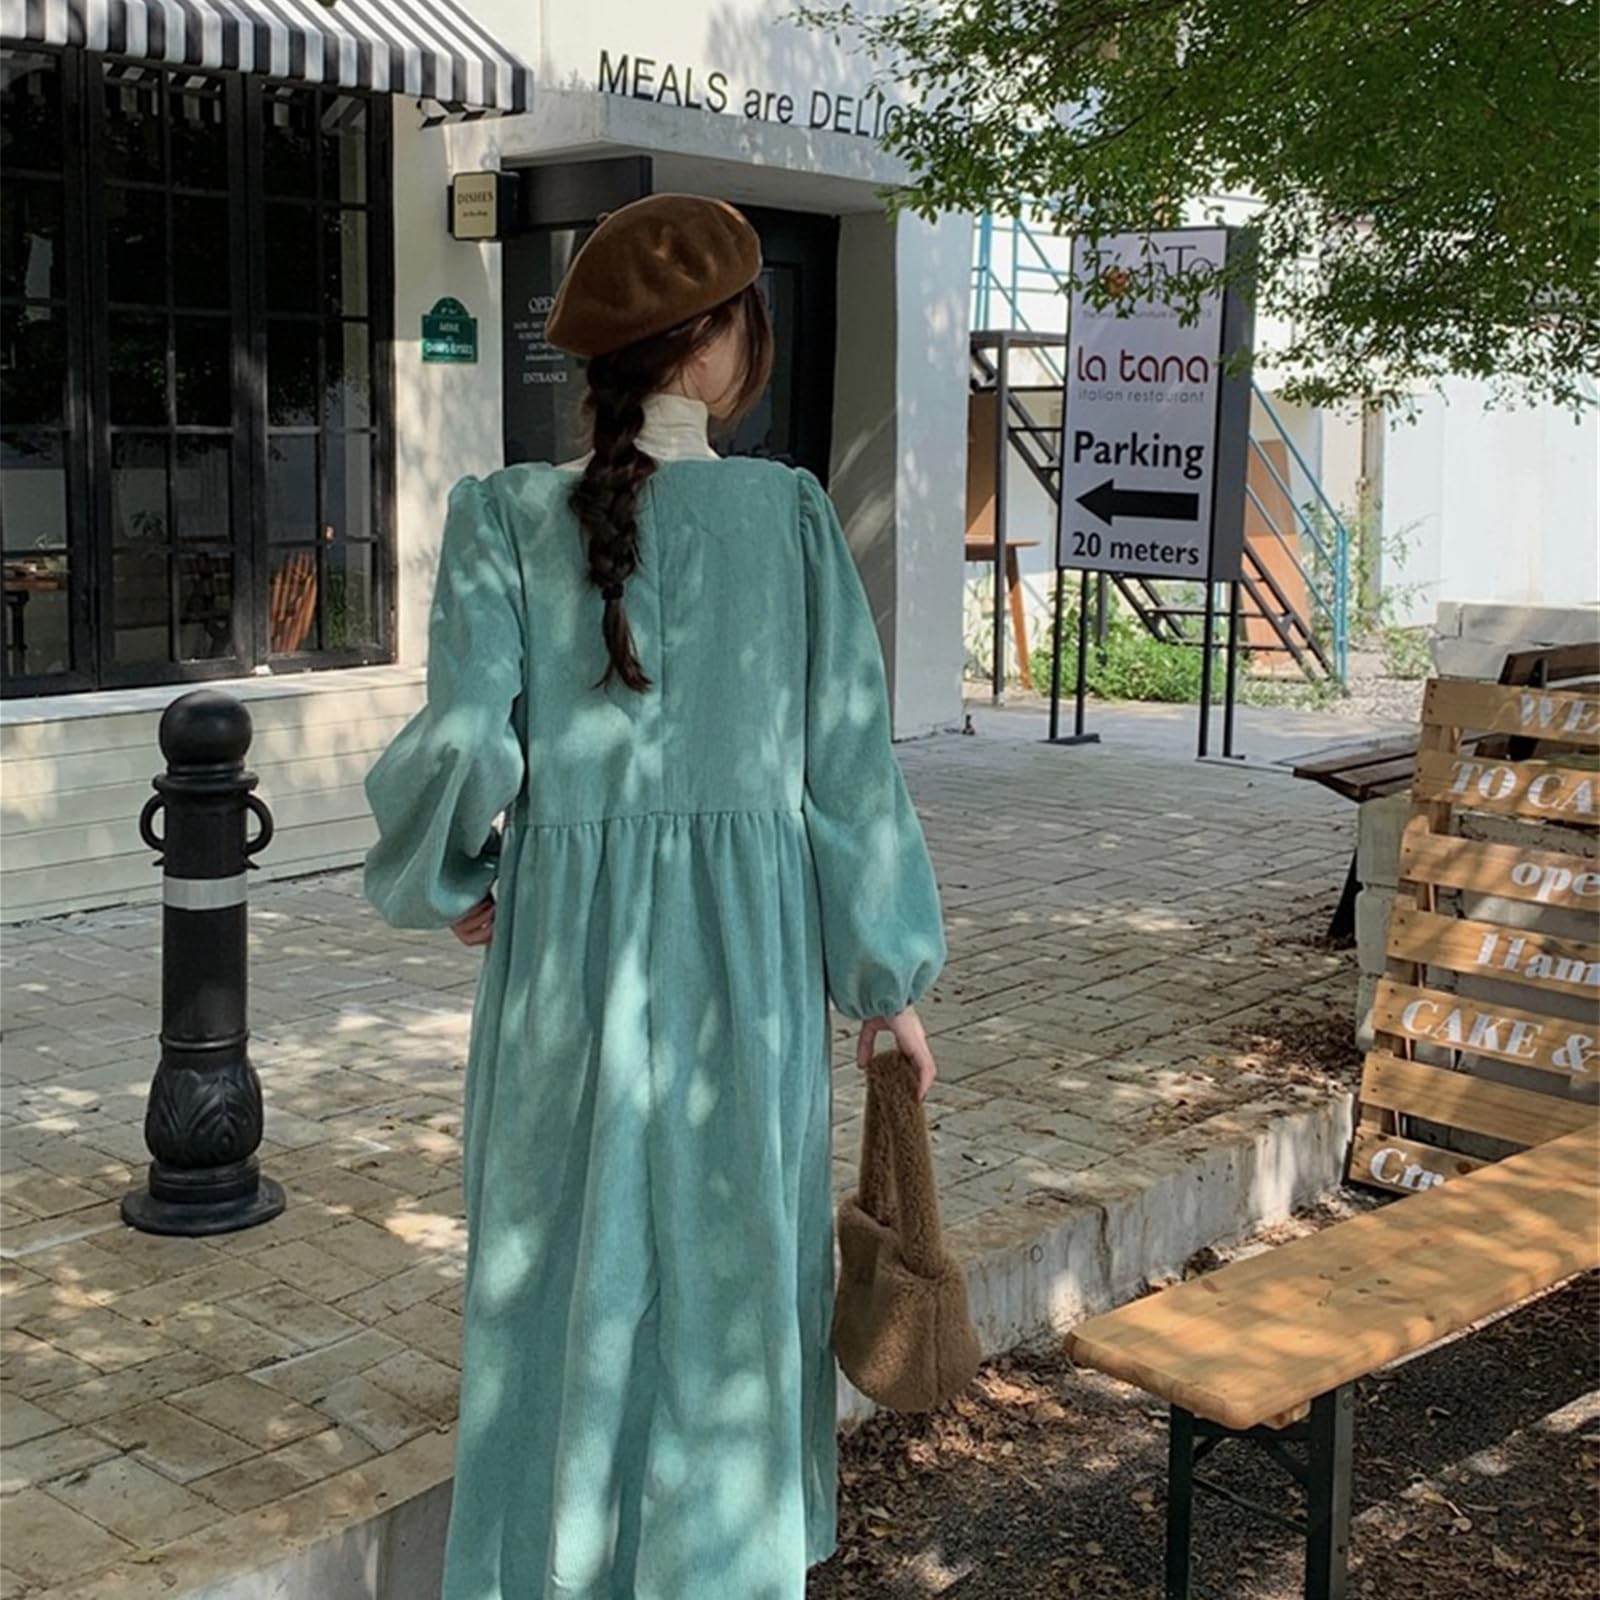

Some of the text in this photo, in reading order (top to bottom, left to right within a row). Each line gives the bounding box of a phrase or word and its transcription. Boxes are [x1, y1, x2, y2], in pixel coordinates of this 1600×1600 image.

[598, 49, 907, 142] MEALS are DELIC
[528, 296, 556, 313] OPE
[522, 371, 568, 385] ENTRANCE
[1077, 346, 1208, 384] la tana
[1078, 388, 1205, 403] italian restaurant
[1073, 430, 1205, 480] Parking
[1072, 531, 1200, 565] 20 meters
[1449, 759, 1517, 801] TO
[1401, 999, 1600, 1073] CAKE &
